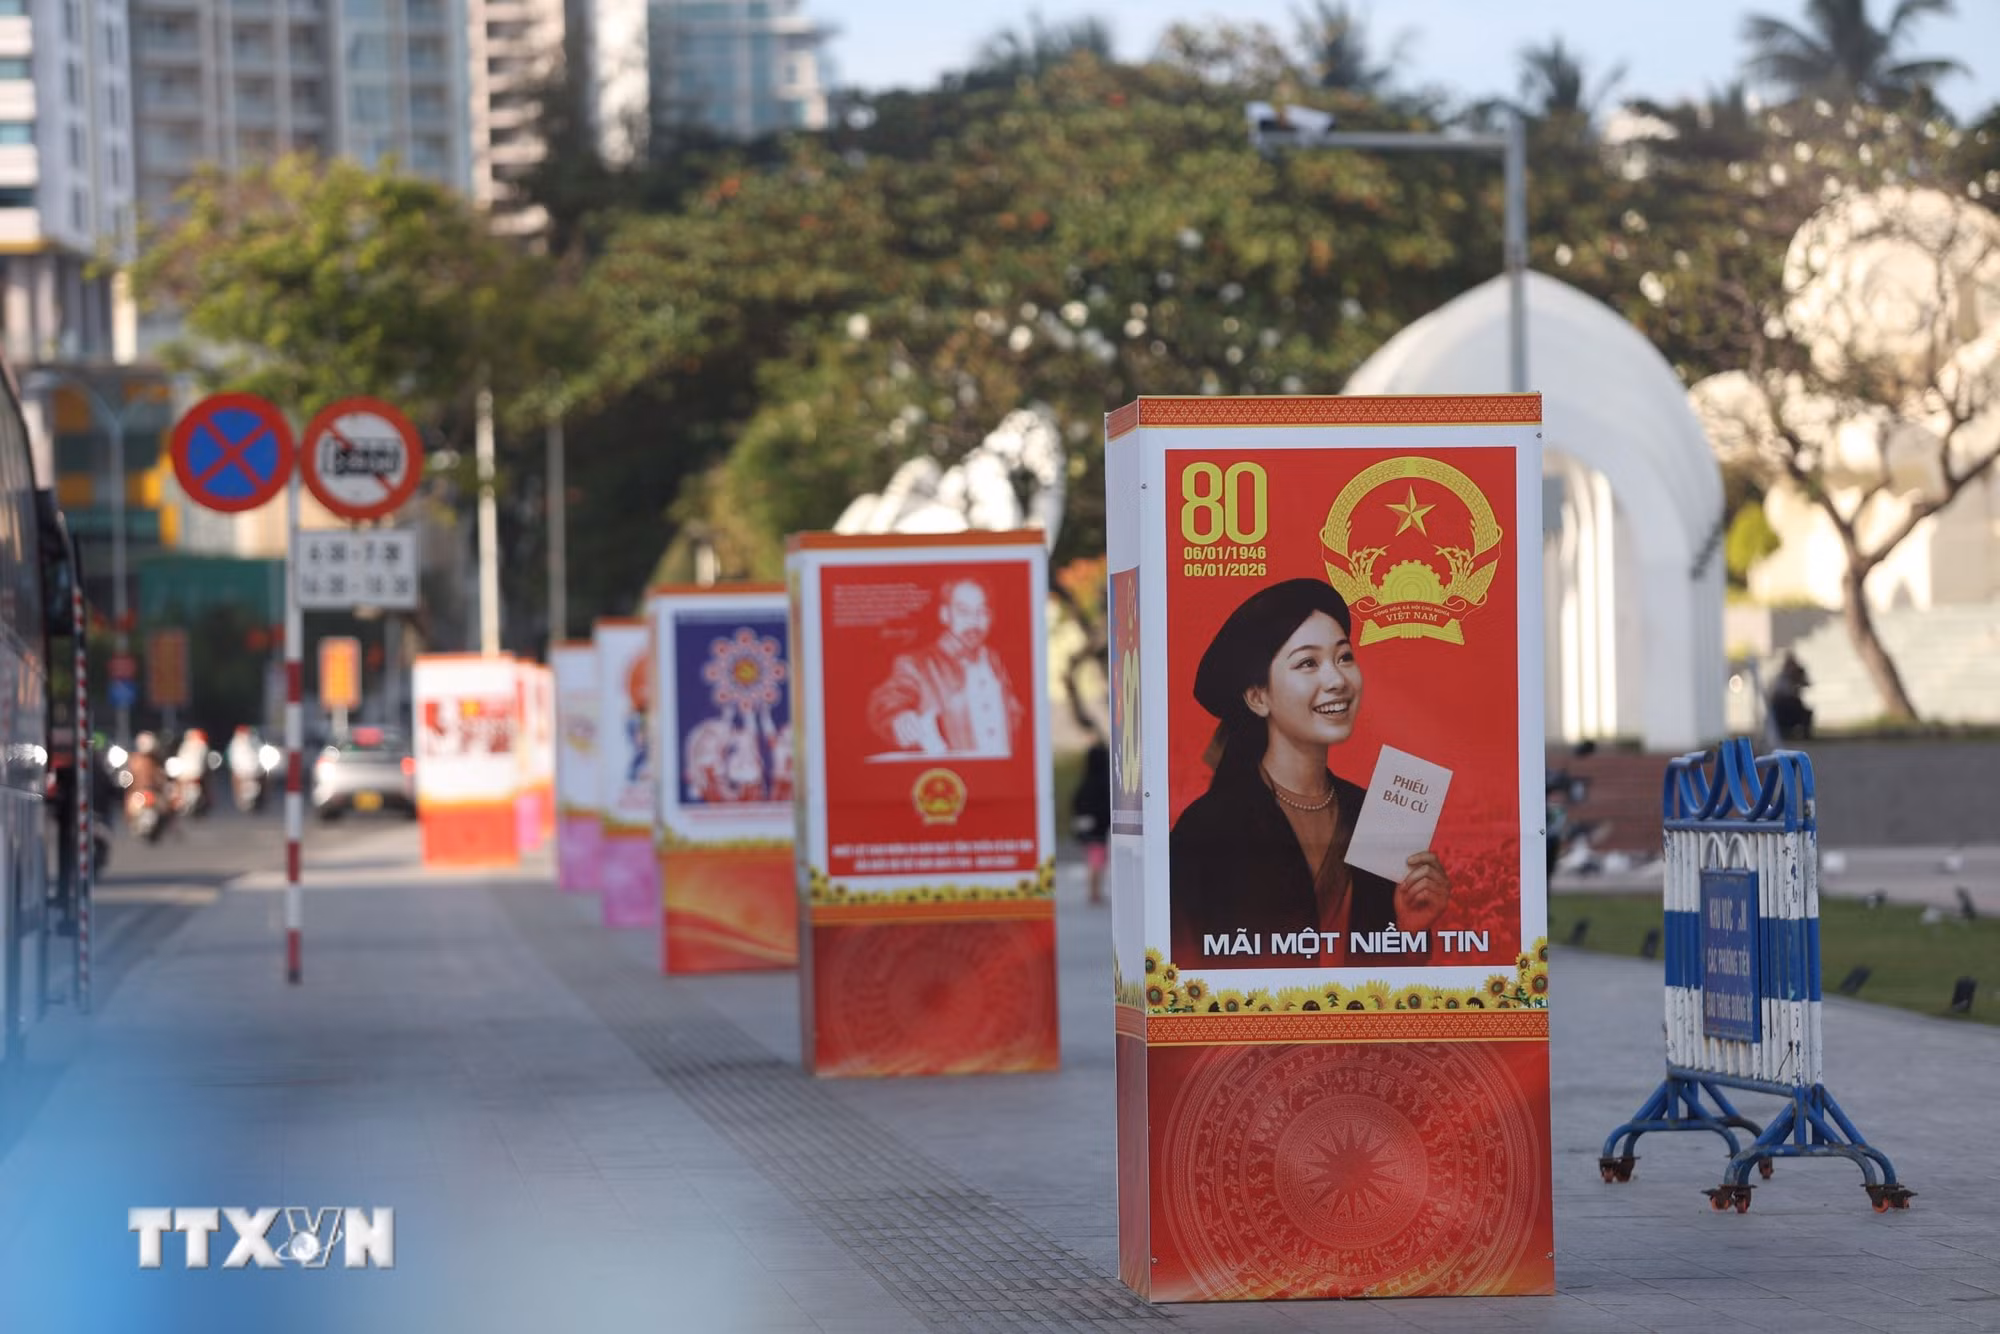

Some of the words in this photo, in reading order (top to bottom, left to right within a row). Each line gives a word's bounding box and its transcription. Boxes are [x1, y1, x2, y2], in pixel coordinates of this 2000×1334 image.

[1181, 461, 1267, 545] 80
[1183, 545, 1267, 560] 06/01/1946
[1183, 562, 1267, 577] 06/01/2026
[1386, 610, 1411, 622] VIỆT
[1413, 612, 1438, 622] NAM
[1393, 774, 1429, 796] PHIẾU
[1410, 798, 1429, 814] CỬ
[1203, 927, 1261, 955] MÃI
[1271, 926, 1340, 959] MỘT
[1350, 921, 1427, 953] NIỀM
[1437, 930, 1489, 952] TIN
